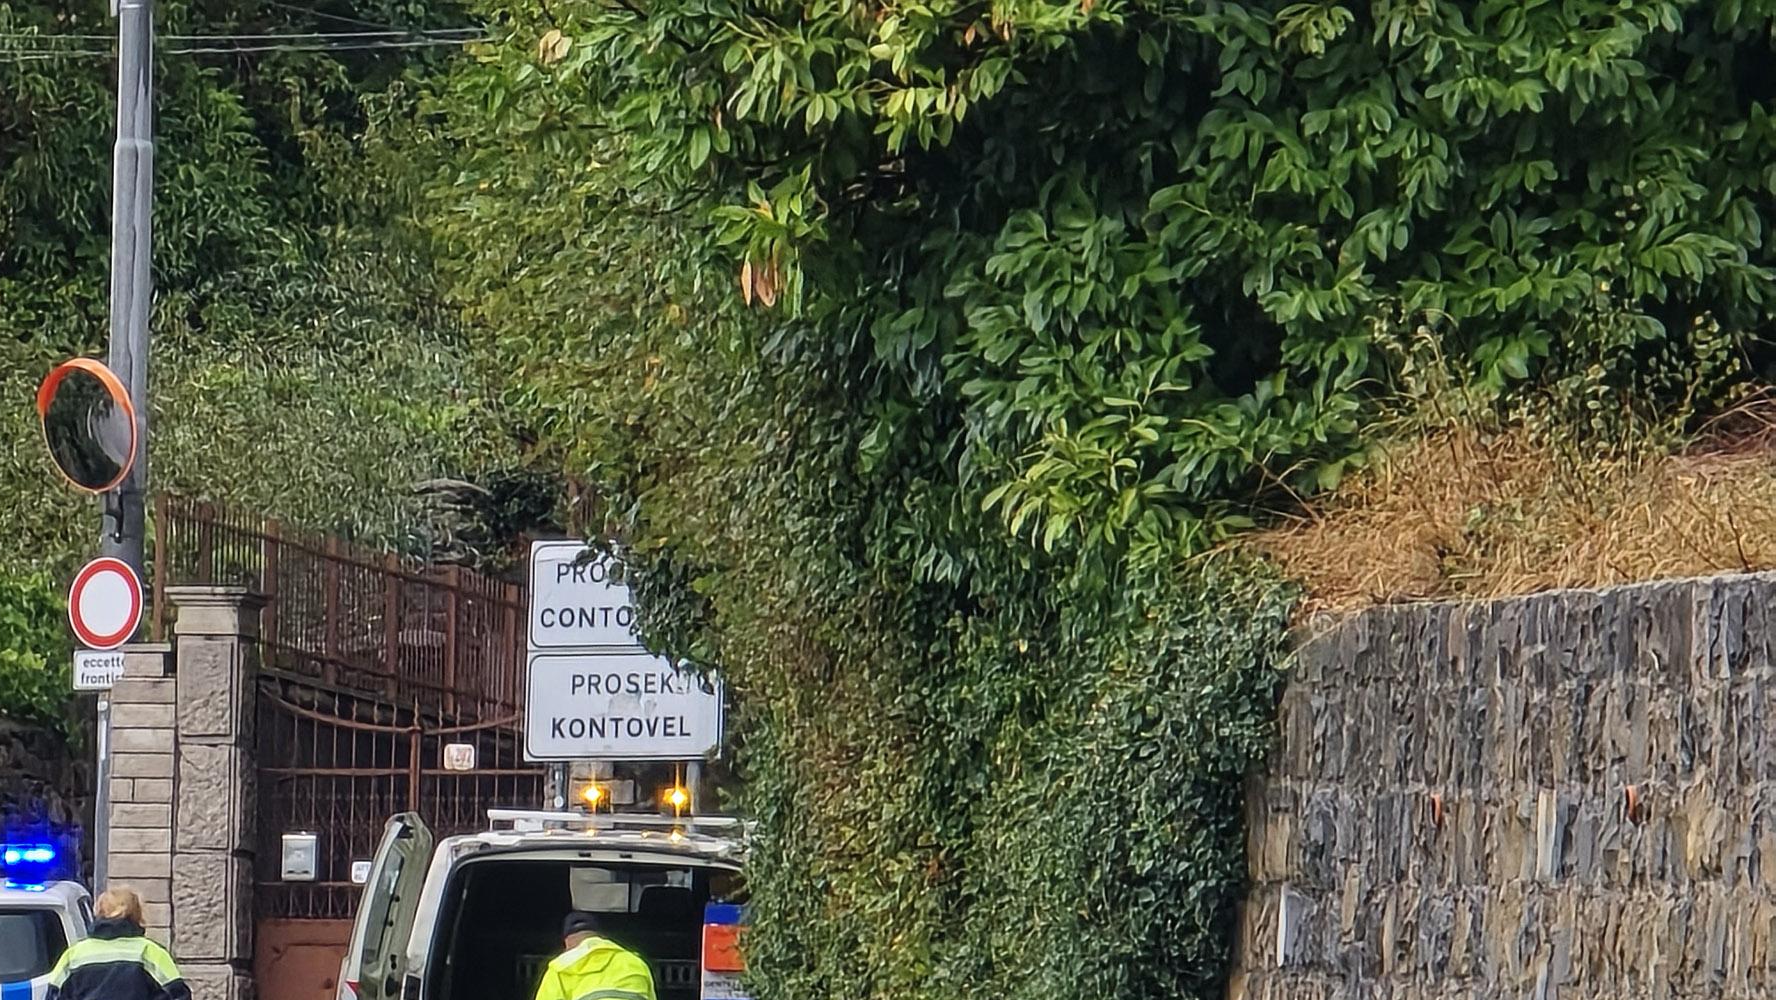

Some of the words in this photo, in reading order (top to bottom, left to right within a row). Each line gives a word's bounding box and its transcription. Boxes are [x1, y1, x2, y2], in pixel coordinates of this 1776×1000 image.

[540, 605, 633, 628] CONTO
[571, 674, 674, 695] PROSEK
[551, 717, 691, 739] KONTOVEL
